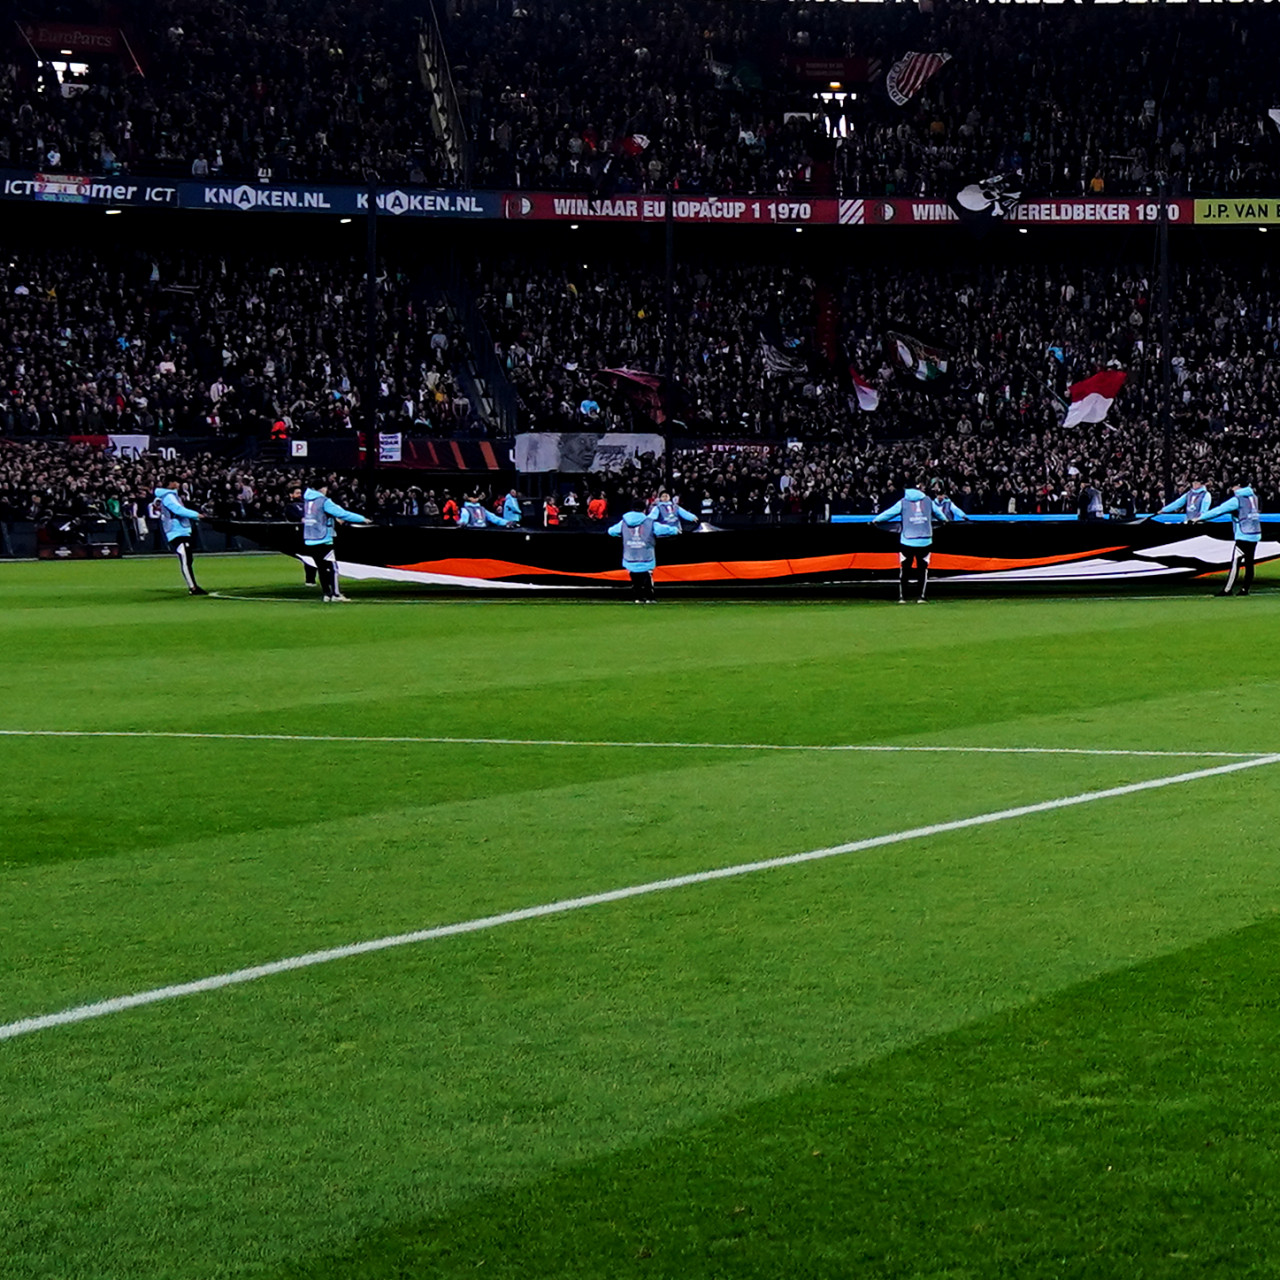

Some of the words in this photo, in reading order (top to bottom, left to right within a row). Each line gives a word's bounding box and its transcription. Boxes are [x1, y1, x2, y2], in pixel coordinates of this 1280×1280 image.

[4, 180, 37, 195] ICT
[91, 184, 138, 200] mer
[144, 187, 176, 202] ICT
[205, 186, 331, 210] KNAKEN.NL
[553, 199, 638, 217] WINNAAR
[752, 201, 760, 219] 1
[768, 202, 811, 219] 1970
[1204, 204, 1230, 218] J.P.
[1235, 204, 1268, 218] VAN
